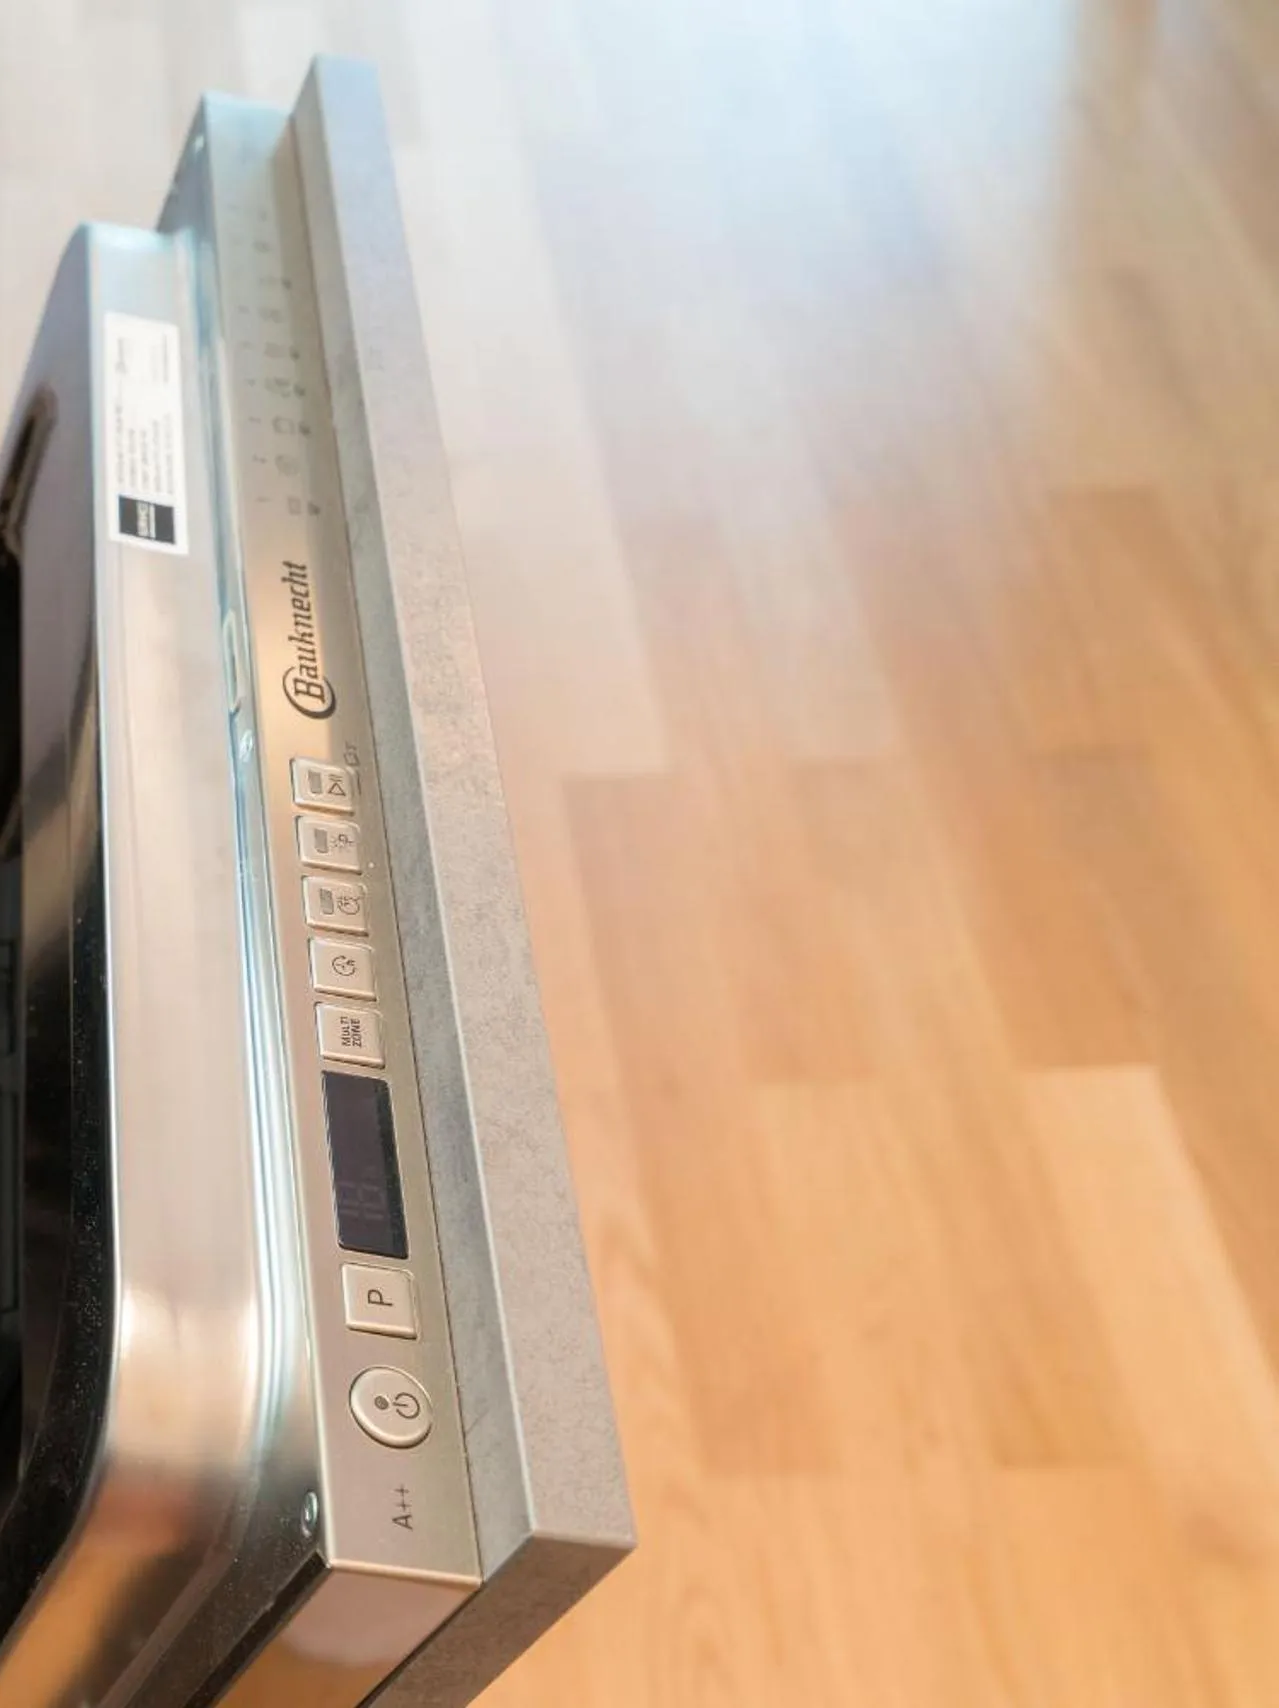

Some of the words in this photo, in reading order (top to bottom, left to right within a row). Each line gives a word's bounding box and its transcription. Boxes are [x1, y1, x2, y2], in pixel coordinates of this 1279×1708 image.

[282, 560, 337, 720] Bauknecht
[351, 1018, 362, 1049] ZONE
[367, 1288, 393, 1307] P
[391, 1484, 414, 1531] A++
